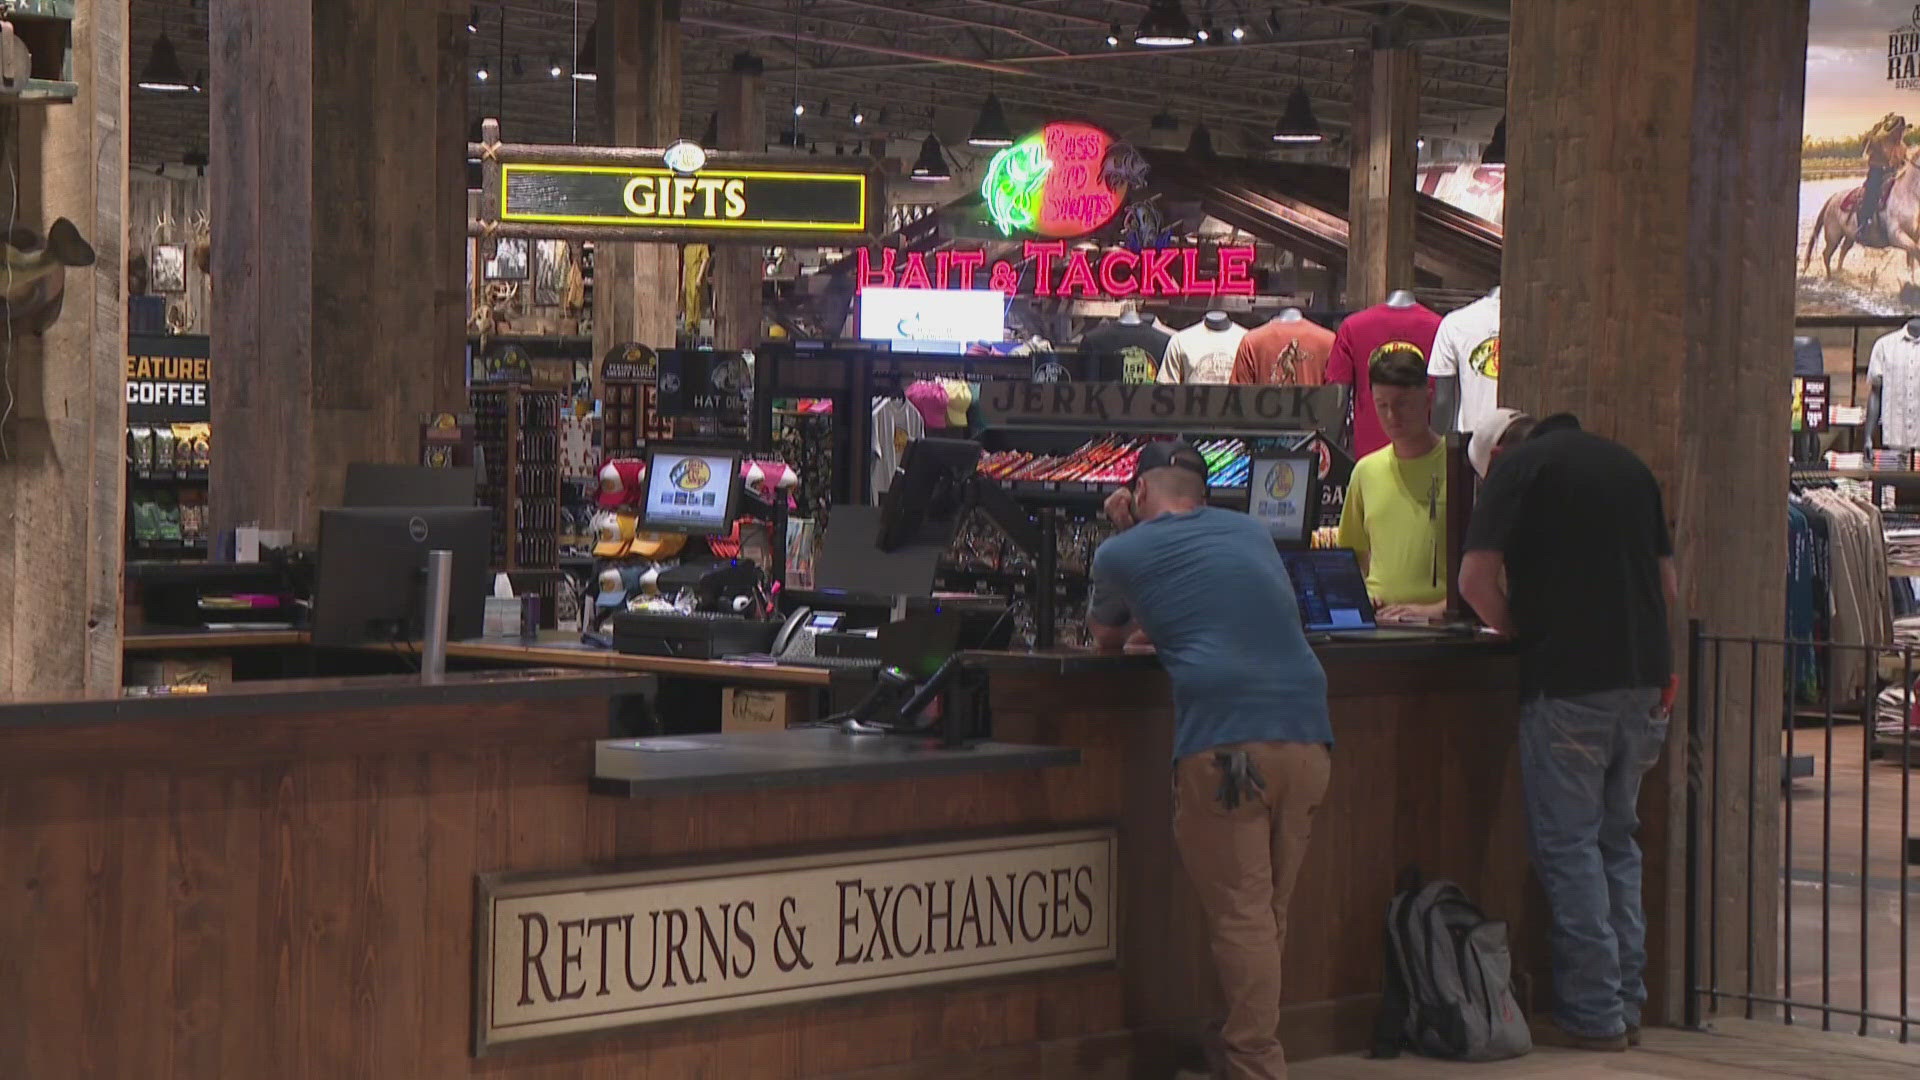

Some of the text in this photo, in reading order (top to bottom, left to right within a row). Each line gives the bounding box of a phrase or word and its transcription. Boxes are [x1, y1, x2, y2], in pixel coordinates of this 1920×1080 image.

[623, 177, 747, 218] GIFTS
[1022, 239, 1257, 298] TACKLE
[126, 381, 206, 406] COFFEE
[694, 394, 721, 409] HAT
[517, 865, 1094, 1007] RETURNS & EXCHANGES
